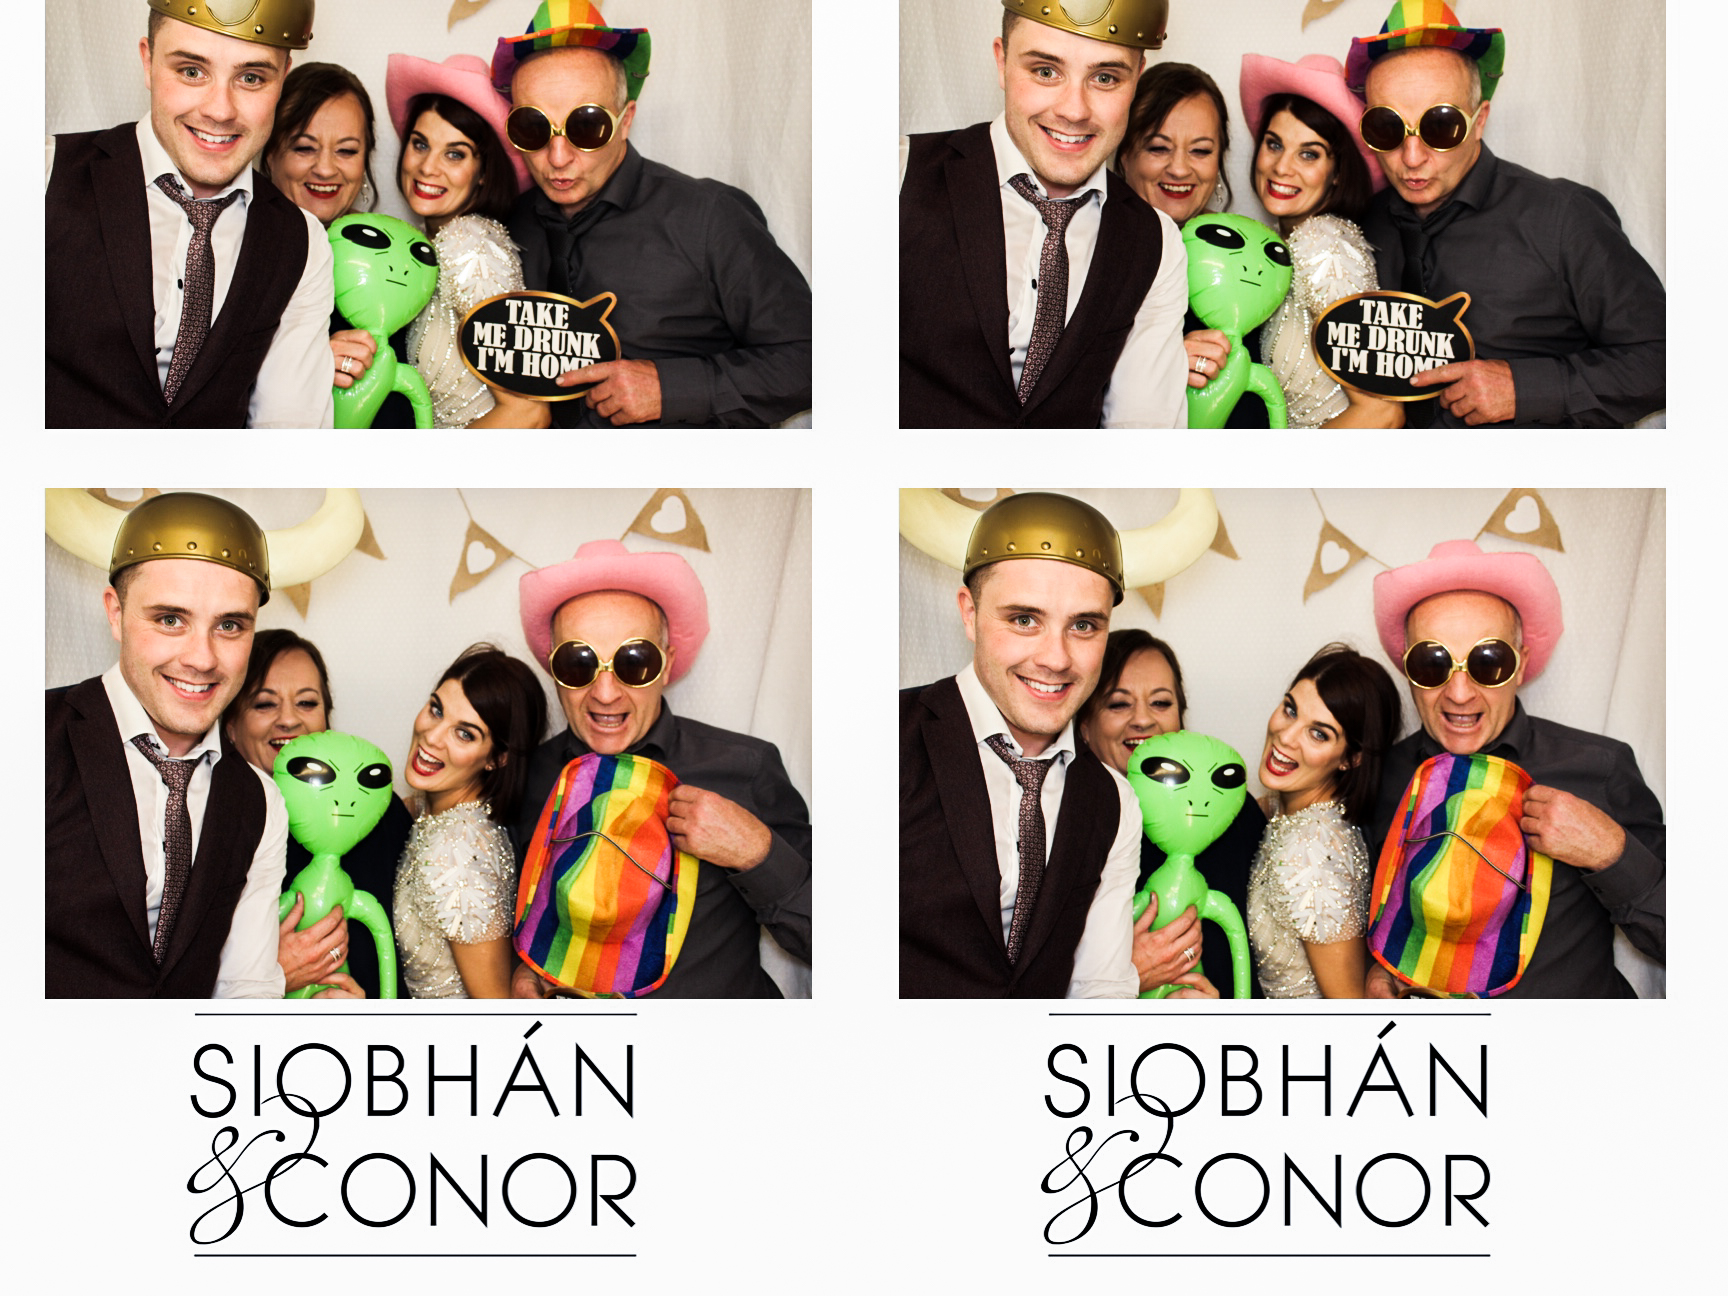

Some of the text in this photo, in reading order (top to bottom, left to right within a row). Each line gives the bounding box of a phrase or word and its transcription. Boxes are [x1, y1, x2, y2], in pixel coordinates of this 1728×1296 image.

[505, 299, 570, 330] TAKE
[1359, 299, 1424, 330] TAKE
[472, 321, 602, 359] ME DRUNK
[1326, 321, 1456, 359] ME DRUNK
[476, 346, 595, 380] I'M HOM
[1330, 346, 1449, 380] I'M HOM
